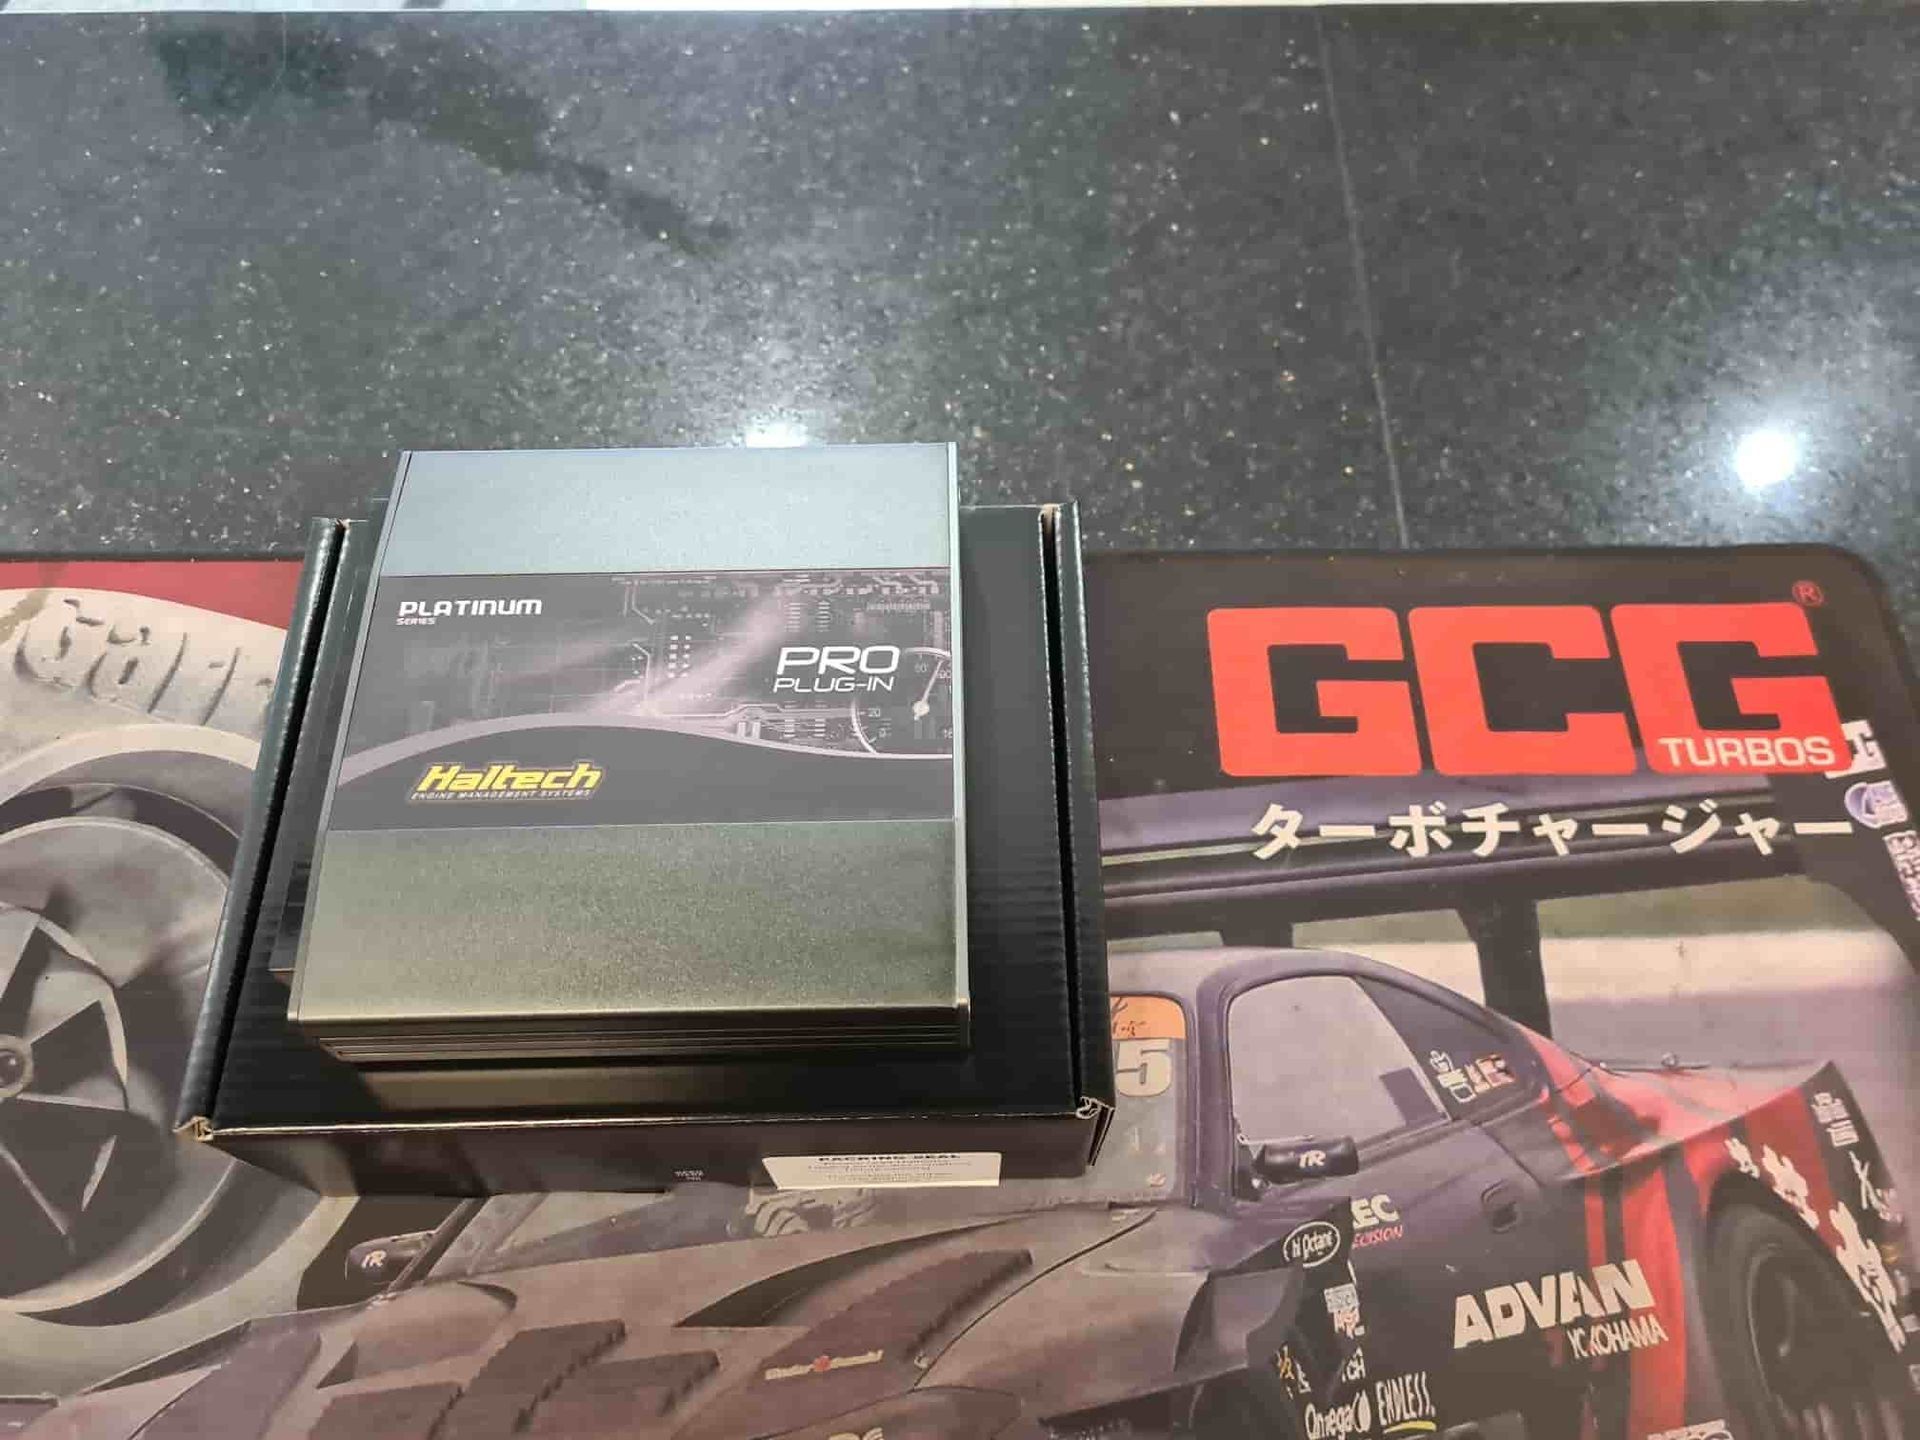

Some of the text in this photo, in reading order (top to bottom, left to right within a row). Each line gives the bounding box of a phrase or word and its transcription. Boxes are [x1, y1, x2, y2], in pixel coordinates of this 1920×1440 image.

[396, 617, 436, 626] SERIES
[399, 599, 542, 617] PLATINUM
[776, 645, 900, 675] PRO
[773, 676, 895, 693] PLUG-IN
[1206, 603, 1853, 776] GCG
[1657, 736, 1835, 767] TURBOS
[416, 762, 602, 793] Haltech
[1252, 799, 1853, 860] ターボチャージャー
[1454, 1259, 1655, 1349] ADVAN
